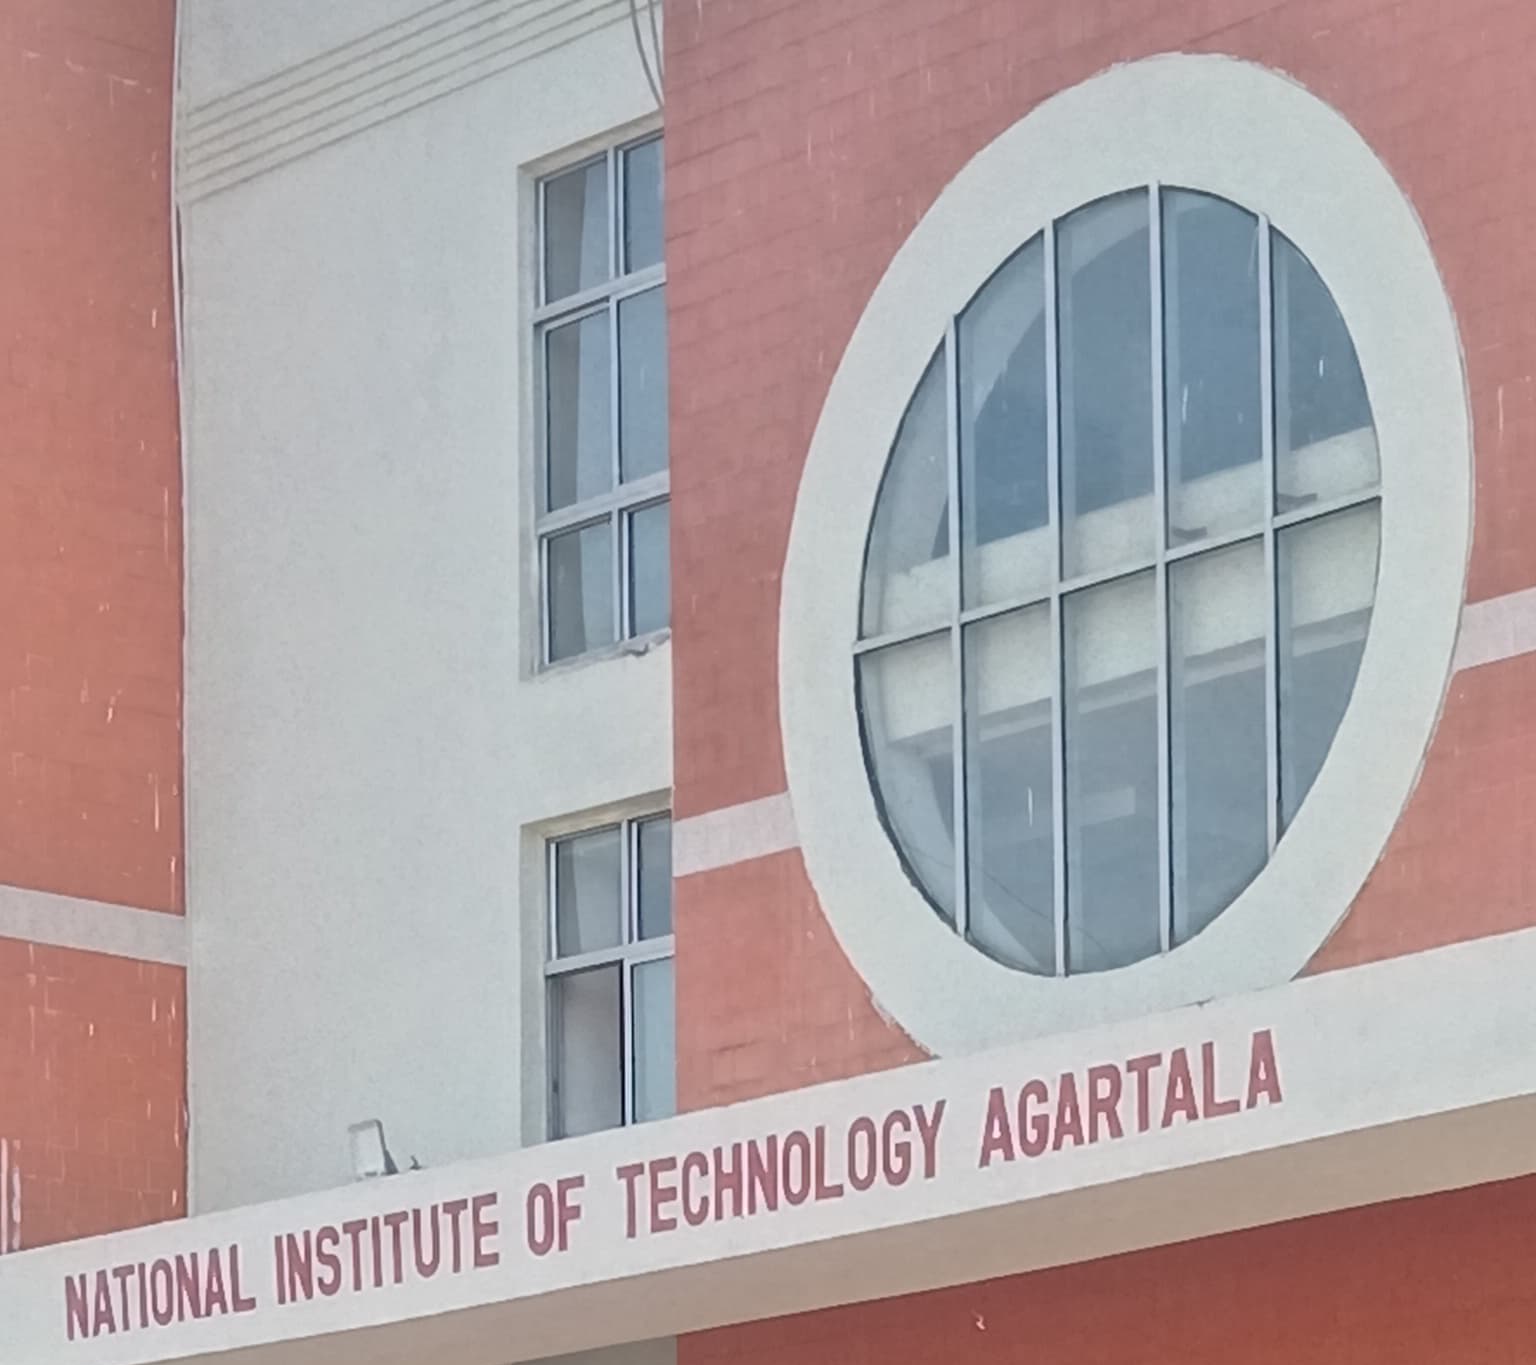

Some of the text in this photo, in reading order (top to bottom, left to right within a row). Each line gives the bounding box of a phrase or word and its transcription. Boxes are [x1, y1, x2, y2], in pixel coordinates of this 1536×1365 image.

[64, 1029, 1283, 1341] NATIONAL INSTITUTE OF TECHNOLOGY AGARTALA
